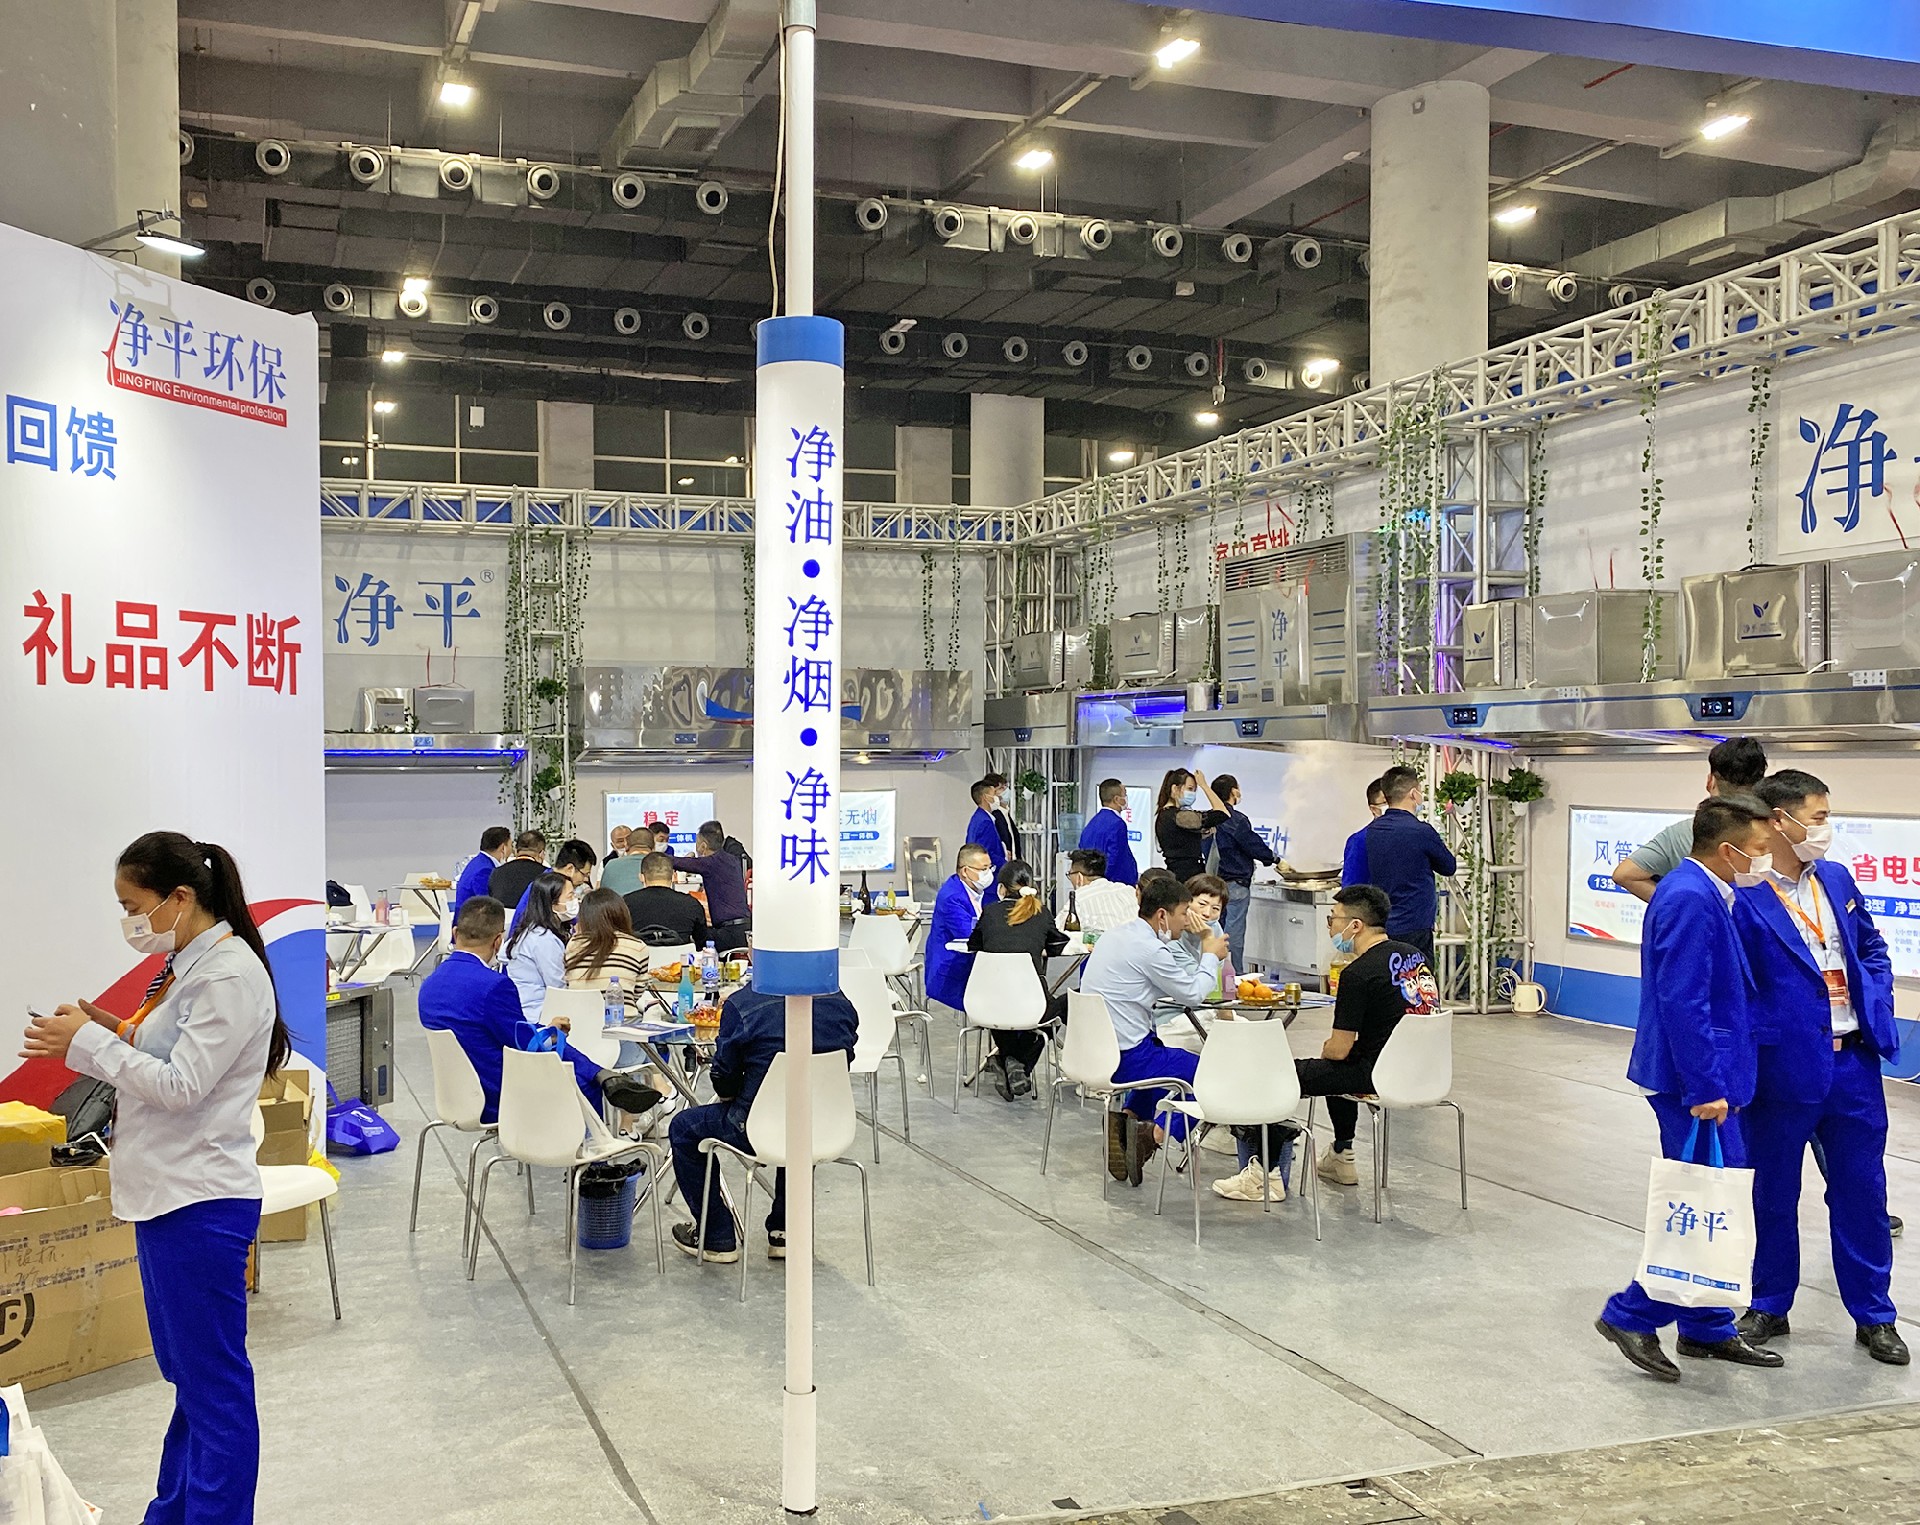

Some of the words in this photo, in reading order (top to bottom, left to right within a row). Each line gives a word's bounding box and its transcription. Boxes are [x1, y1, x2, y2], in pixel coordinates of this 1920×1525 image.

[101, 299, 287, 404] 净平环保
[117, 371, 143, 388] JING
[144, 380, 171, 395] PING
[173, 385, 240, 412] Environmental
[240, 402, 284, 423] protection
[6, 394, 118, 481] 回馈
[1796, 403, 1920, 534] 净
[22, 589, 302, 696] 礼品不断
[1271, 608, 1290, 680] 净平
[1594, 840, 1645, 866] 风管
[1665, 1201, 1729, 1242] 净平
